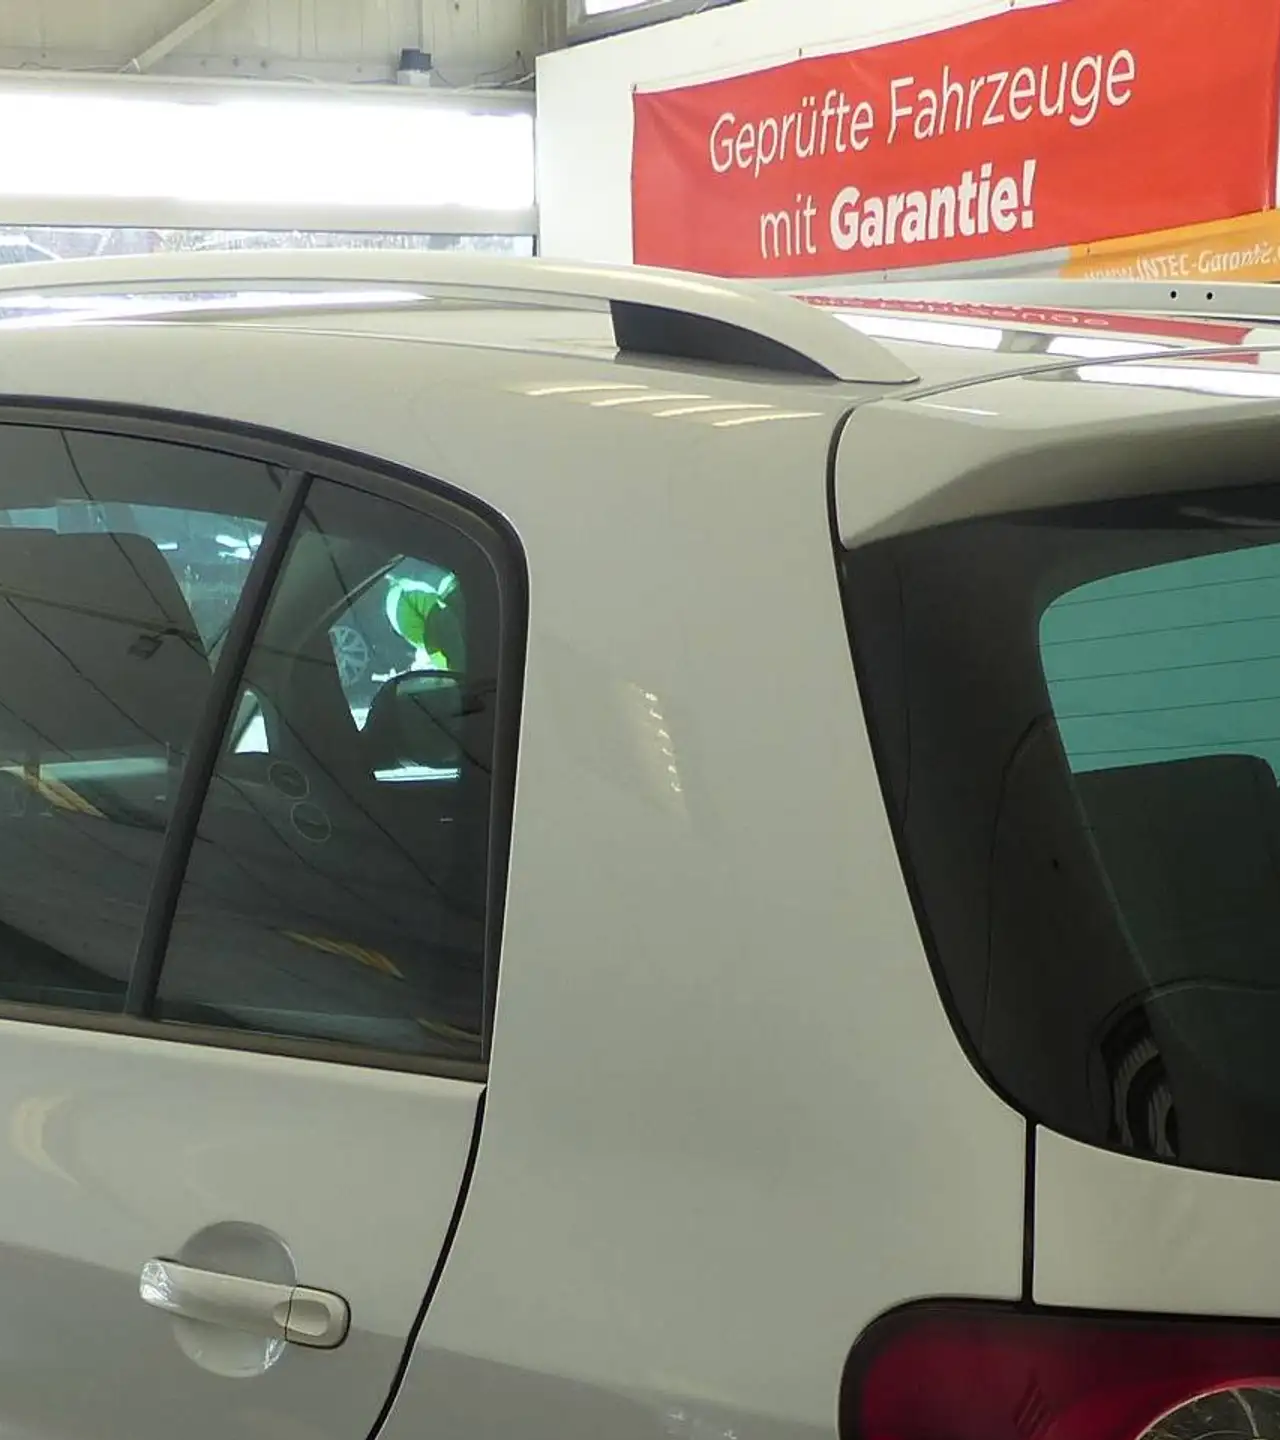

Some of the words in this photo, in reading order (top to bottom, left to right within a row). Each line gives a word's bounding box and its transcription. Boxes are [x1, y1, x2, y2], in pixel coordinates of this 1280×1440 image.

[708, 84, 875, 178] Geprüfte
[887, 47, 1137, 143] Fahrzeuge
[759, 193, 817, 260] mit
[830, 158, 1037, 250] Garantie!
